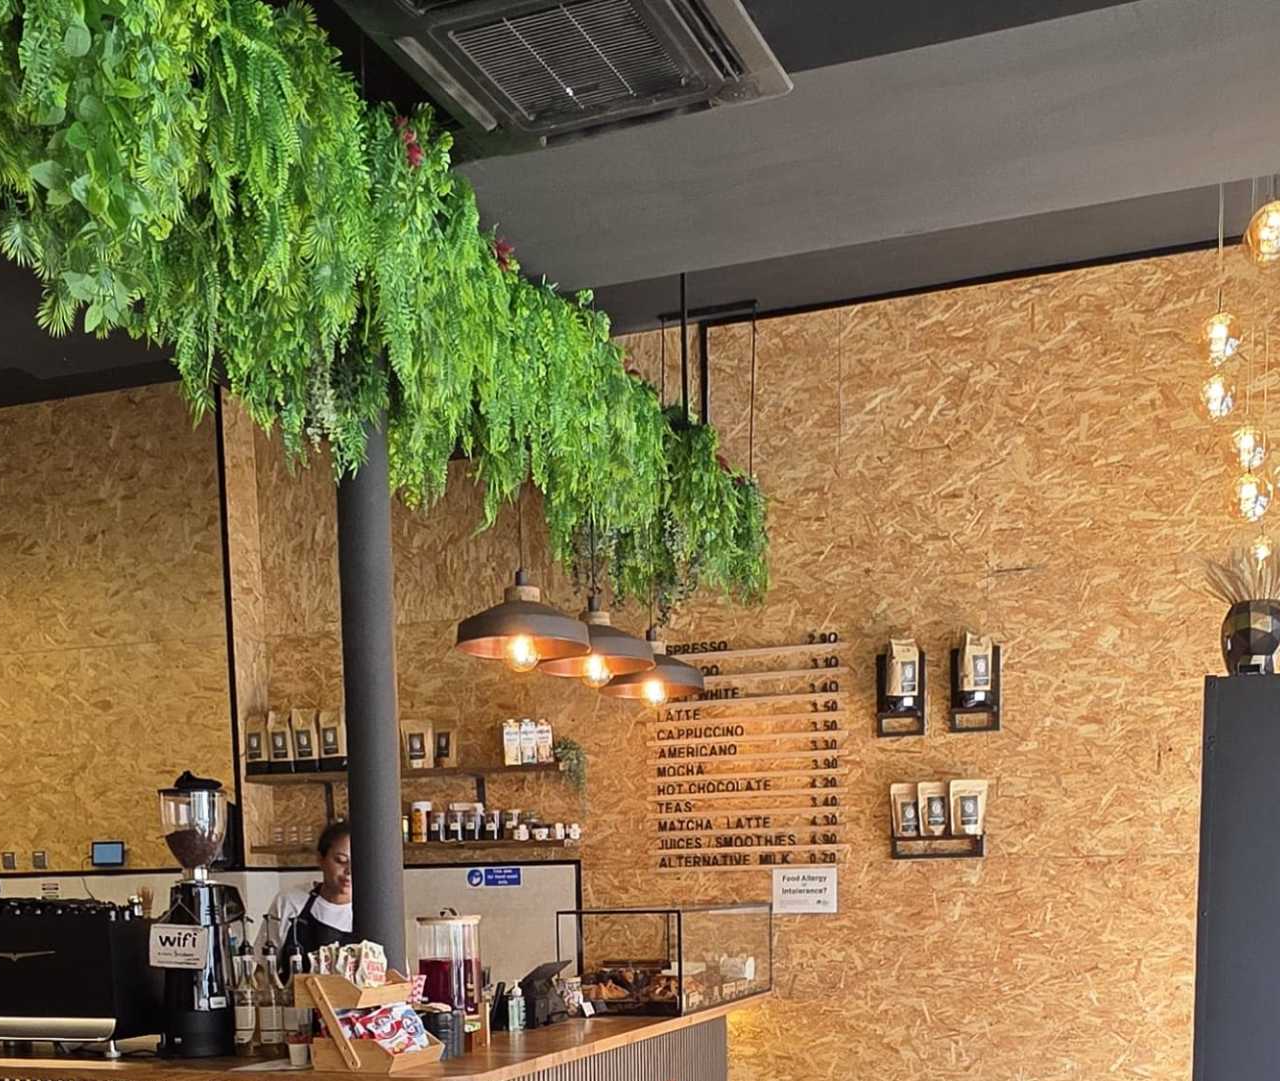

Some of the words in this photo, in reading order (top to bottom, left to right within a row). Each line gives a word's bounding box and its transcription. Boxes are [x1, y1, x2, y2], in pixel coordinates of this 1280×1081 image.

[664, 640, 728, 656] SPRESSO
[656, 708, 701, 722] LATTE
[656, 724, 745, 741] CAPPUCCINO
[658, 743, 737, 759] AMERICANO
[656, 762, 705, 777] MOCHA
[656, 783, 684, 796] HOT
[688, 779, 772, 795] CHOCOLATE
[656, 800, 693, 814] TEAS
[657, 819, 713, 832] MATCHA
[726, 816, 771, 830] LATTE
[658, 836, 702, 850] JUICES
[714, 833, 797, 849] SMOOTHIES
[659, 853, 751, 868] ALTERNATIVE
[758, 852, 792, 866] MILK
[158, 931, 198, 949] wifi
